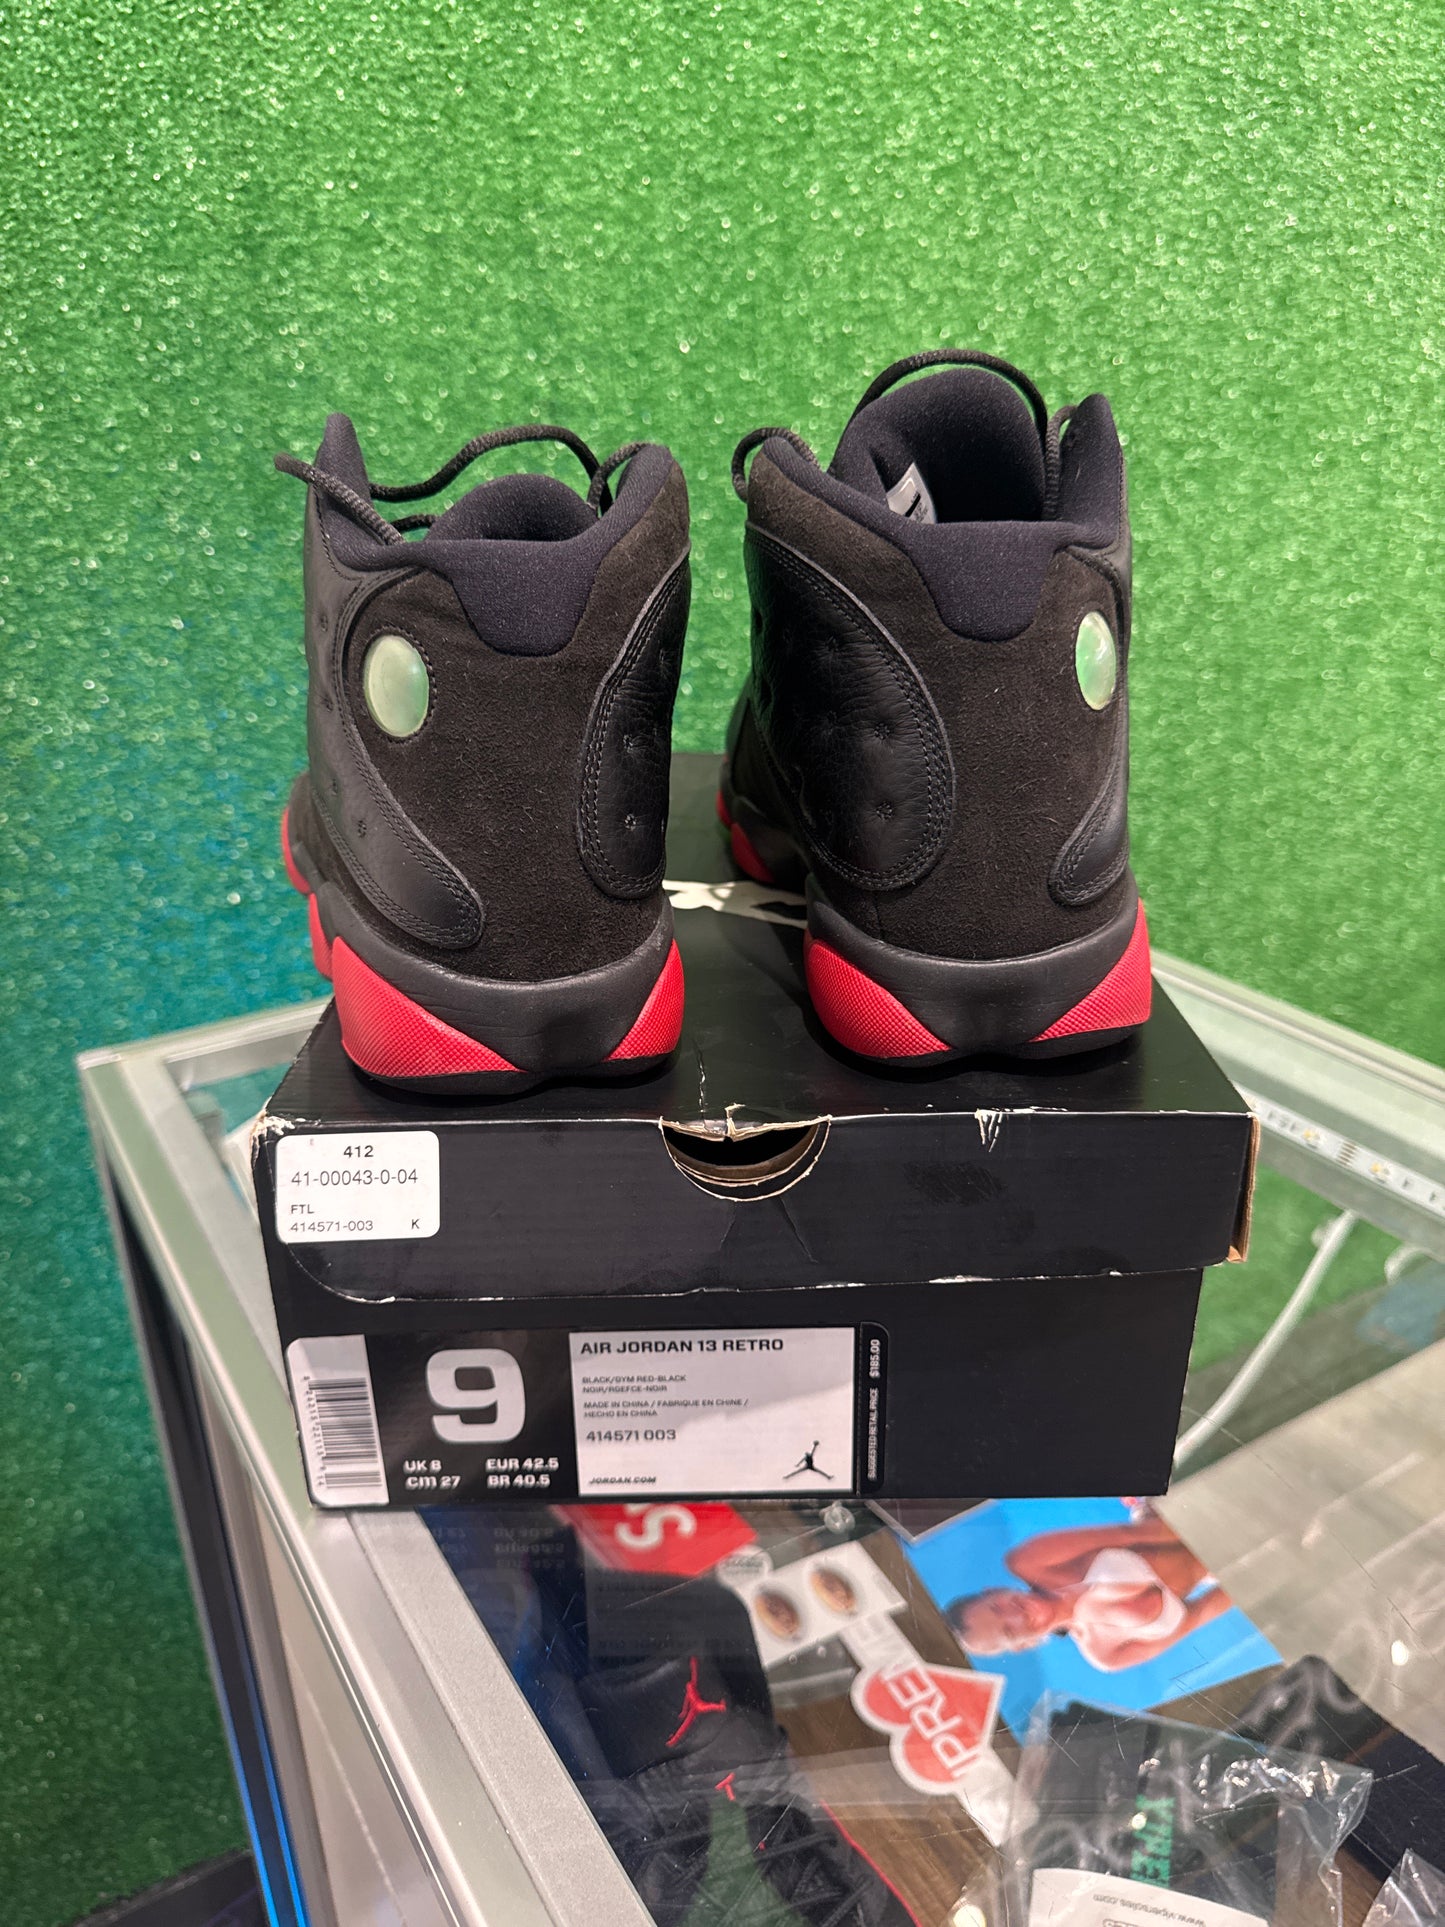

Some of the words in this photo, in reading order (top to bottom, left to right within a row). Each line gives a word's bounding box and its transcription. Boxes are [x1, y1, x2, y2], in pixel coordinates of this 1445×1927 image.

[343, 1145, 374, 1158] 412
[291, 1169, 418, 1186] 41-00043-0-04
[290, 1204, 315, 1214] FTL
[290, 1220, 374, 1232] 414571-003
[411, 1219, 420, 1229] K
[581, 1342, 612, 1354] AIR
[616, 1340, 693, 1353] JORDAN
[697, 1339, 717, 1351] 13
[722, 1338, 784, 1351] RETRO
[869, 1339, 880, 1378] $185.00
[426, 1348, 526, 1443] 9
[869, 1387, 879, 1410] PRICE
[583, 1401, 609, 1409] MADE
[583, 1411, 615, 1419] HECHO
[629, 1410, 658, 1418] CHINA
[868, 1410, 878, 1435] RETAIL
[586, 1430, 640, 1442] 414571
[643, 1429, 677, 1441] 003
[485, 1458, 520, 1472] EUR
[521, 1457, 559, 1471] 42.5
[867, 1435, 878, 1481] SUGGESTED
[403, 1460, 428, 1473] UK
[439, 1475, 461, 1488] 27
[488, 1475, 511, 1489] BR
[512, 1474, 551, 1488] 40.5
